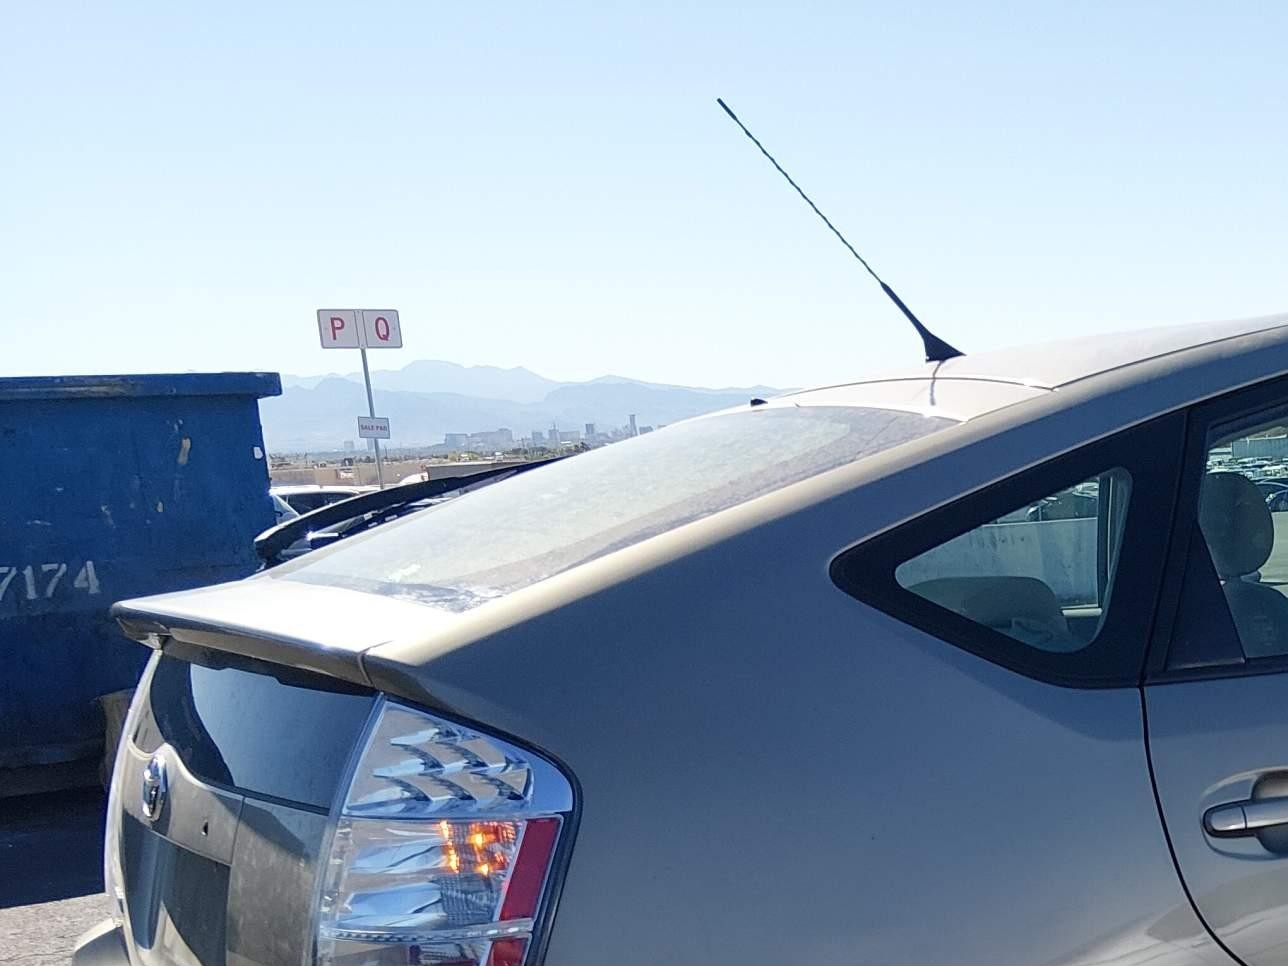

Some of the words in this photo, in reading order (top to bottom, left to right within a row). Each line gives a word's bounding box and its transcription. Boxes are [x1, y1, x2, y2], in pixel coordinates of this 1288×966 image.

[330, 317, 345, 341] P
[375, 316, 389, 342] Q
[0, 560, 100, 600] 7174
